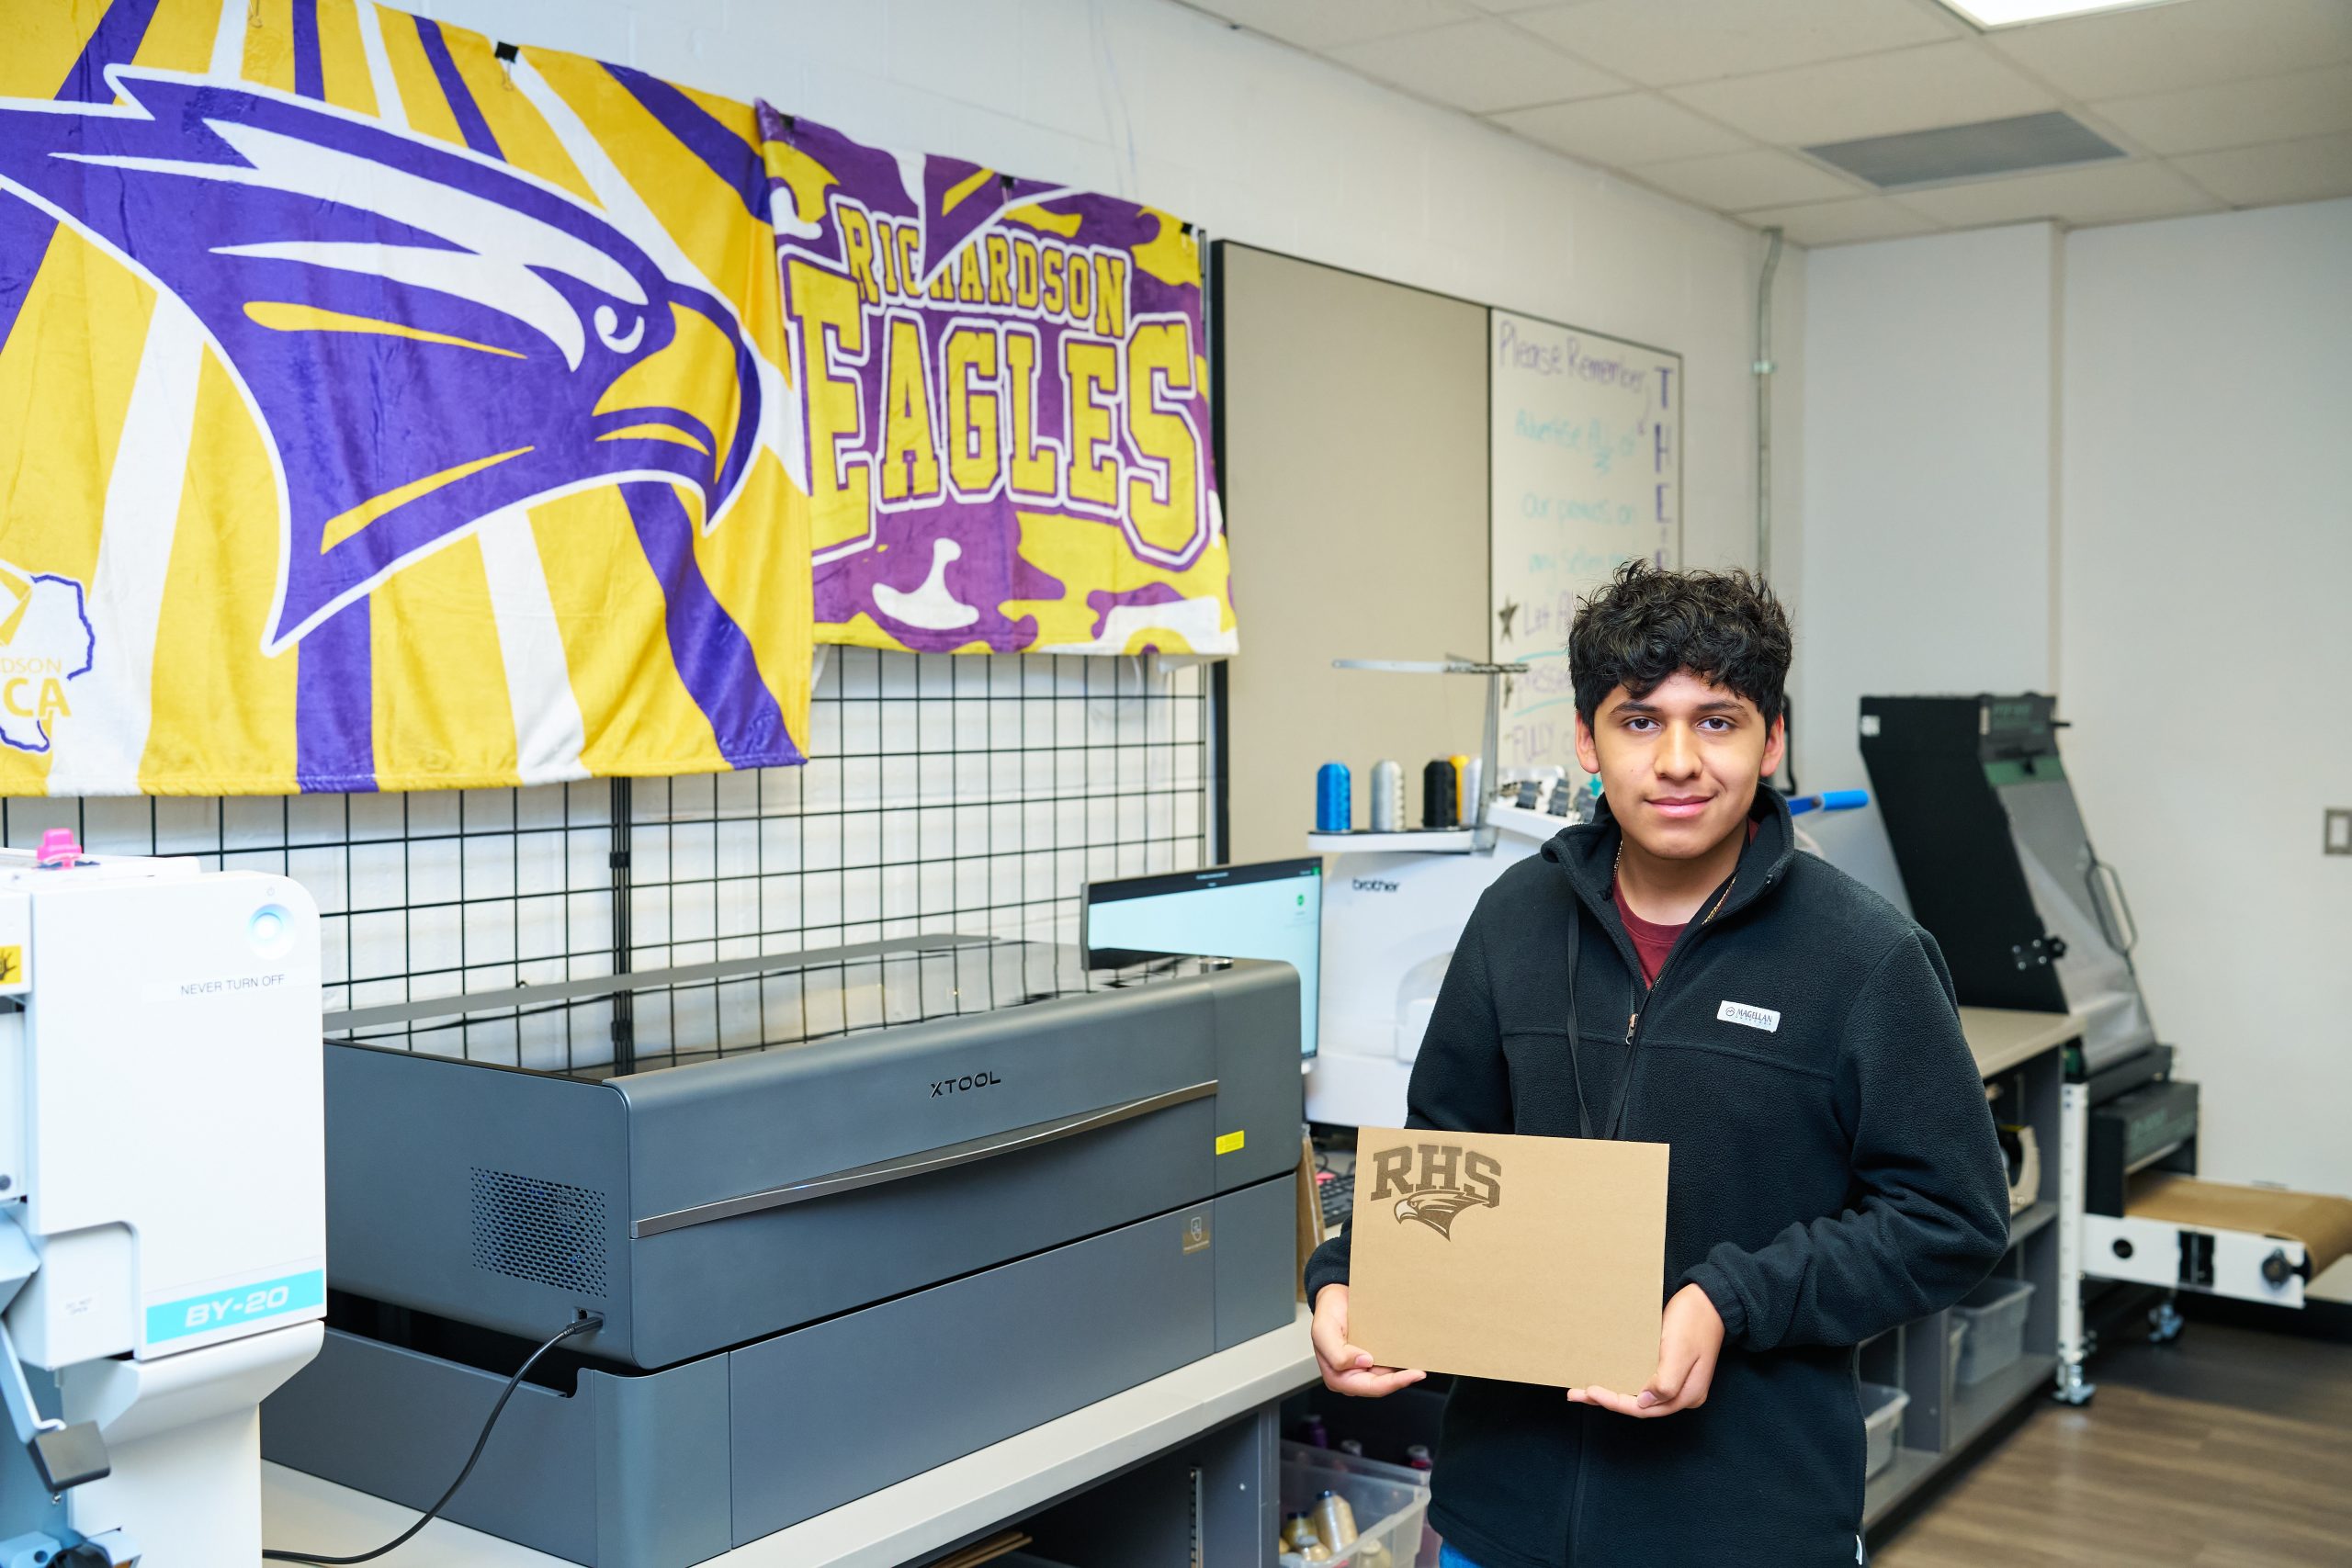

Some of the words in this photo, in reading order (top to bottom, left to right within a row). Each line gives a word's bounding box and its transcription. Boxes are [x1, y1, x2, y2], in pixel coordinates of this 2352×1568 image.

[787, 257, 1201, 553] EAGLES
[181, 981, 222, 995] NEVER
[226, 977, 258, 990] TURN
[262, 974, 285, 987] OFF
[1736, 1009, 1773, 1023] MAGELLAN
[930, 1071, 1001, 1099] XTOOL
[1370, 1144, 1502, 1209] RHS
[186, 1286, 289, 1328] BY-20
